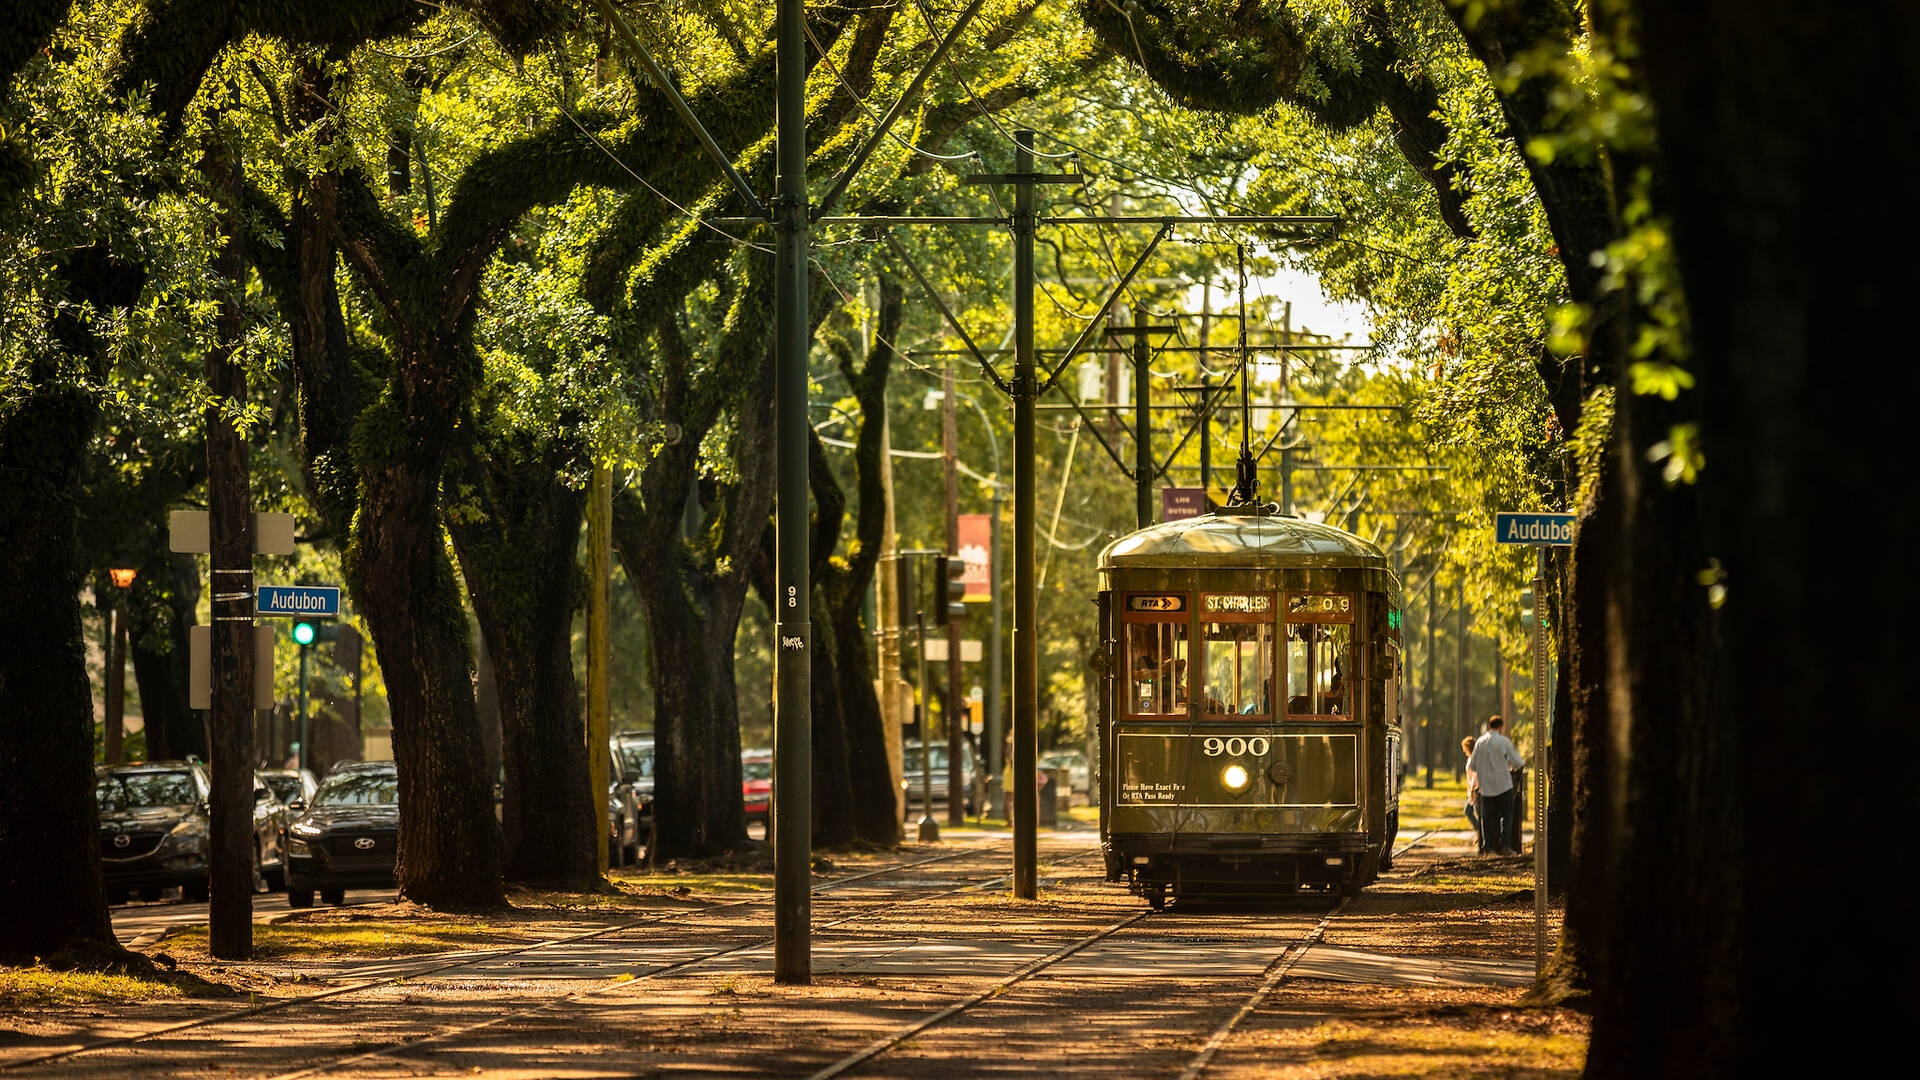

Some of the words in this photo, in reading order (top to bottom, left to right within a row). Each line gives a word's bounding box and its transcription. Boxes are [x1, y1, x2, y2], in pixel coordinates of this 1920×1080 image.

[1175, 496, 1190, 504] LIVE
[1168, 507, 1198, 515] OUTSIDE
[270, 590, 326, 610] Audubon
[1141, 599, 1159, 608] RTA
[1207, 597, 1221, 610] ST.
[1222, 596, 1267, 610] CHARLES
[1203, 737, 1270, 757] 900
[1122, 783, 1139, 791] Please
[1140, 783, 1154, 791] Have
[1155, 783, 1172, 791] Exact
[1173, 783, 1186, 791] Fae
[1131, 792, 1143, 800] RTA
[1144, 792, 1157, 800] Pass
[1157, 792, 1175, 801] Ready
